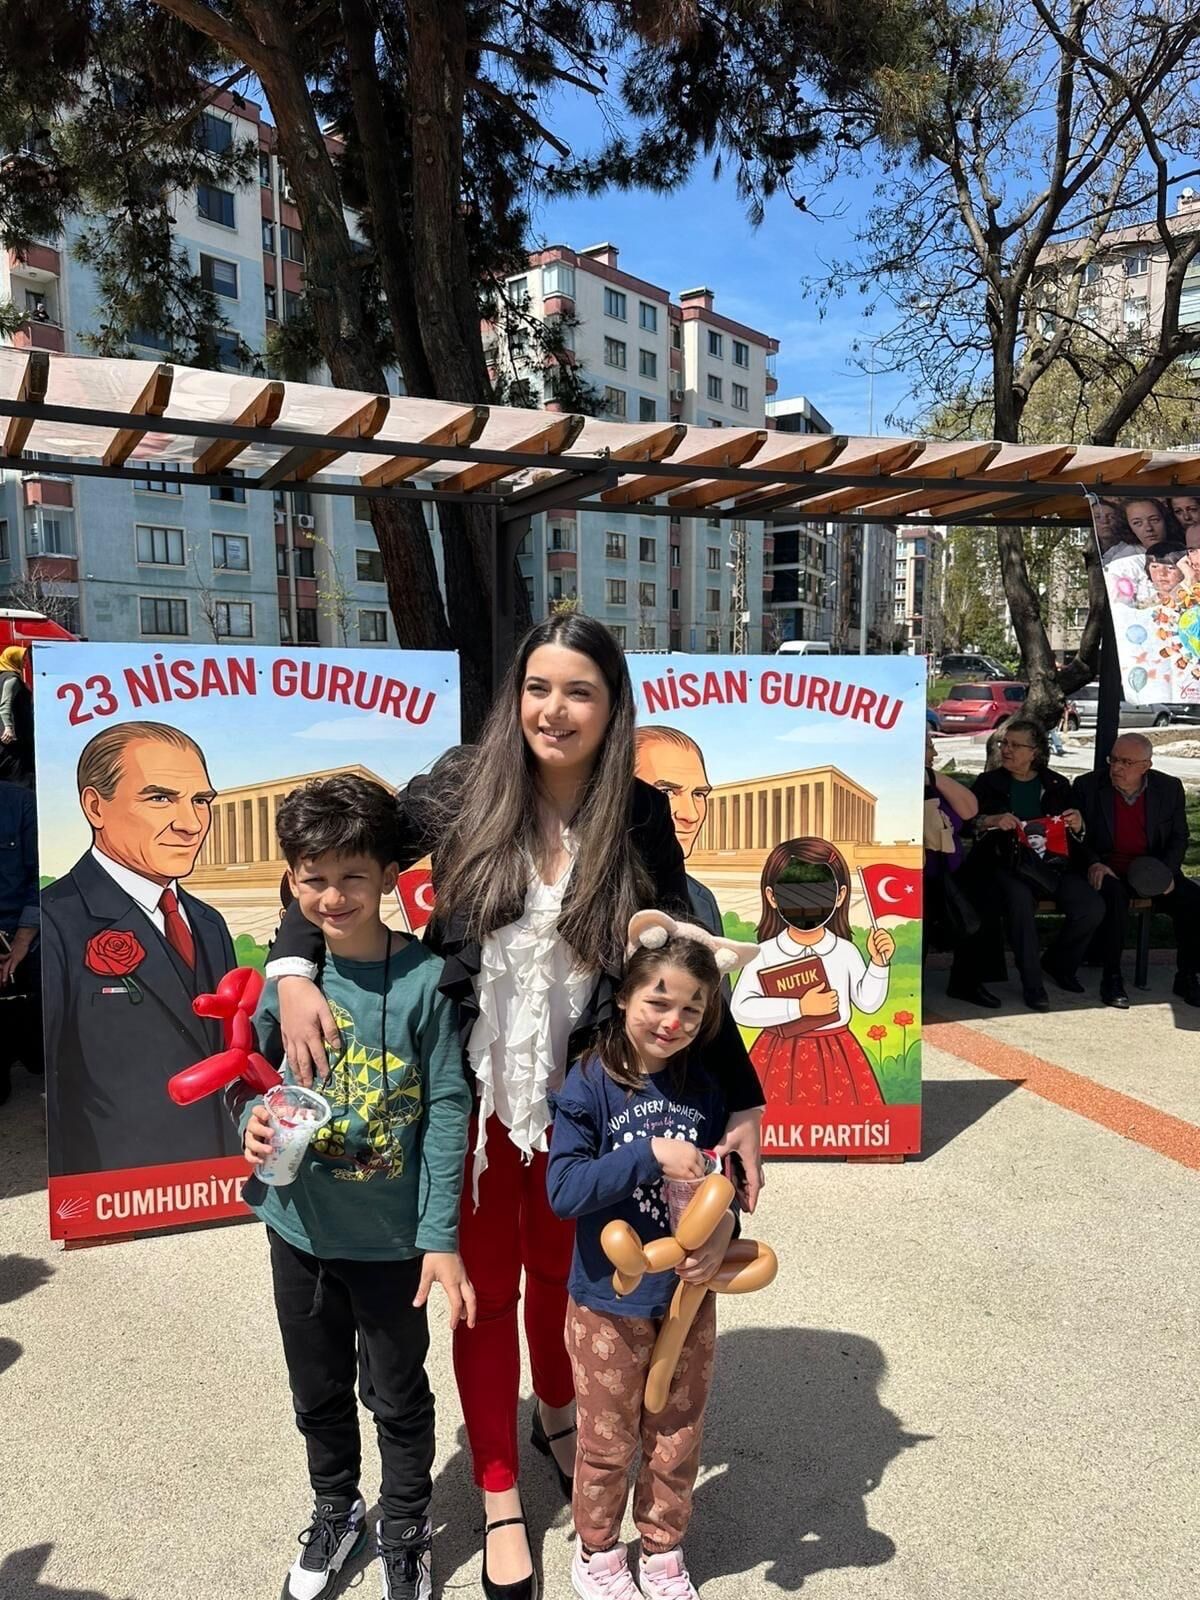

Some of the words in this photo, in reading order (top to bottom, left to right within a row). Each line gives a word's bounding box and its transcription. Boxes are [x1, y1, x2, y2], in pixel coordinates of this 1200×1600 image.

[56, 674, 119, 727] 23
[123, 653, 257, 708] NİSAN
[272, 658, 437, 726] GURURU
[642, 667, 748, 714] NİSAN
[760, 670, 904, 730] GURURU
[776, 968, 819, 992] NUTUK
[633, 1099, 665, 1117] EVERY
[667, 1101, 706, 1124] MOMENT
[760, 1123, 805, 1147] ALK
[810, 1119, 890, 1147] PARTİSİ
[96, 1174, 249, 1220] CUMHURİYE
